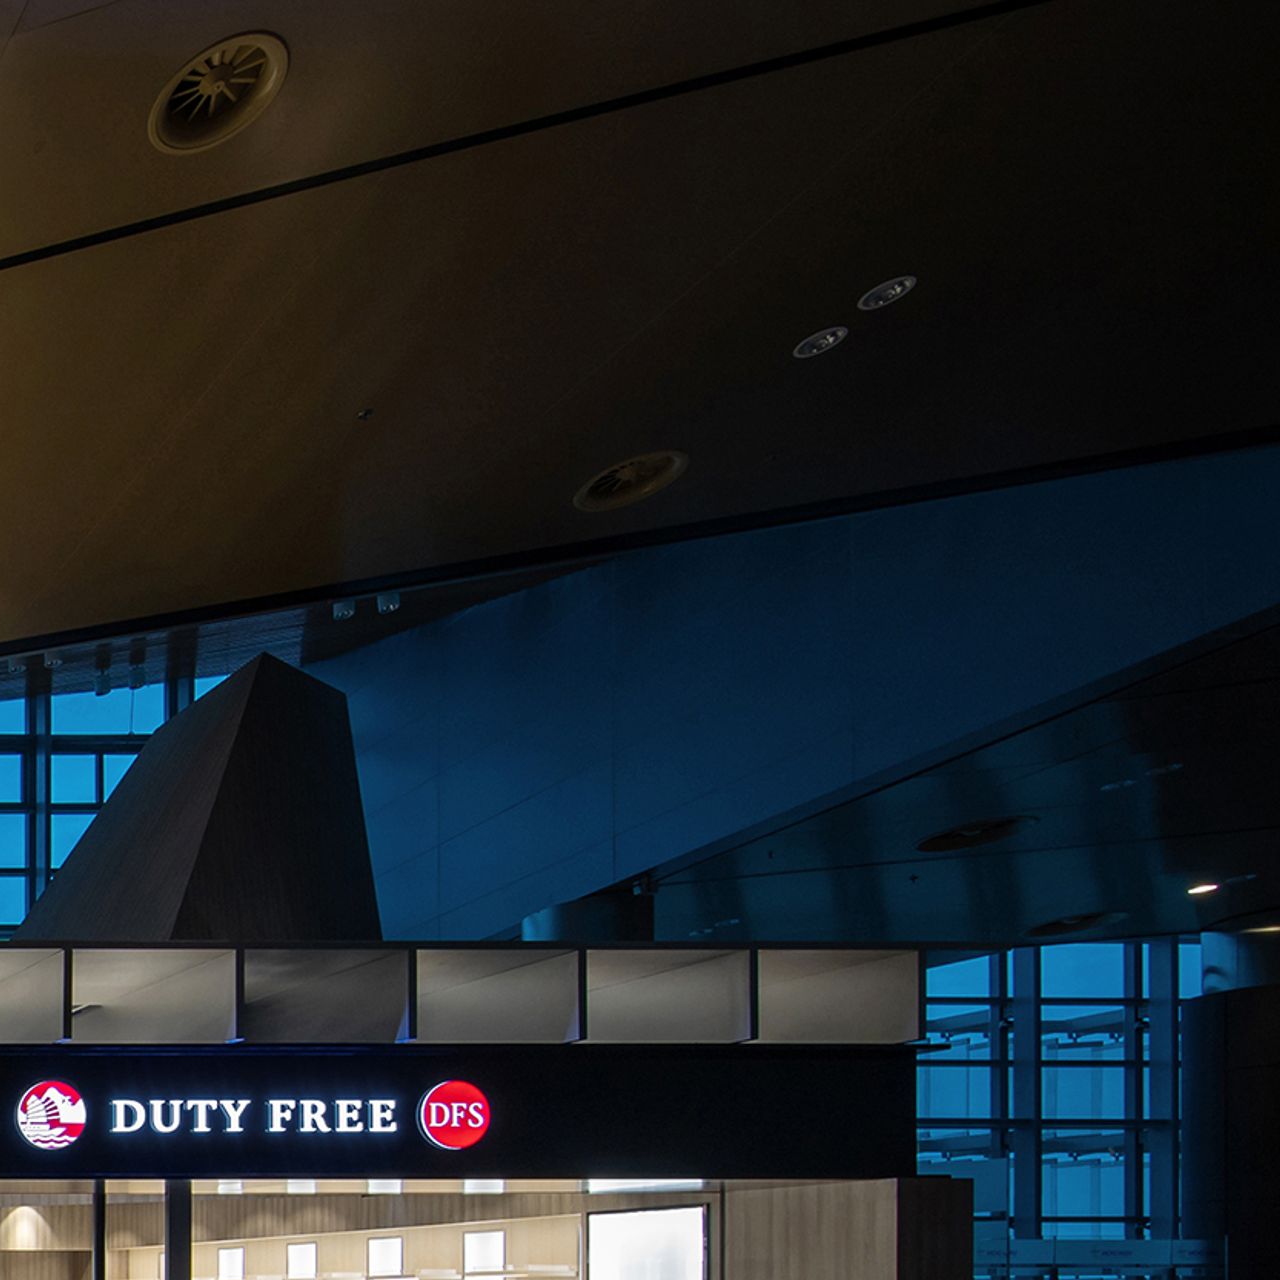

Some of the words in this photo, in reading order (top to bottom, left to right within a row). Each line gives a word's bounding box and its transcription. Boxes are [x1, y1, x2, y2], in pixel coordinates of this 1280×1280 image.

[109, 1099, 251, 1133] DUTY
[265, 1099, 397, 1133] FREE
[427, 1102, 485, 1129] DFS
